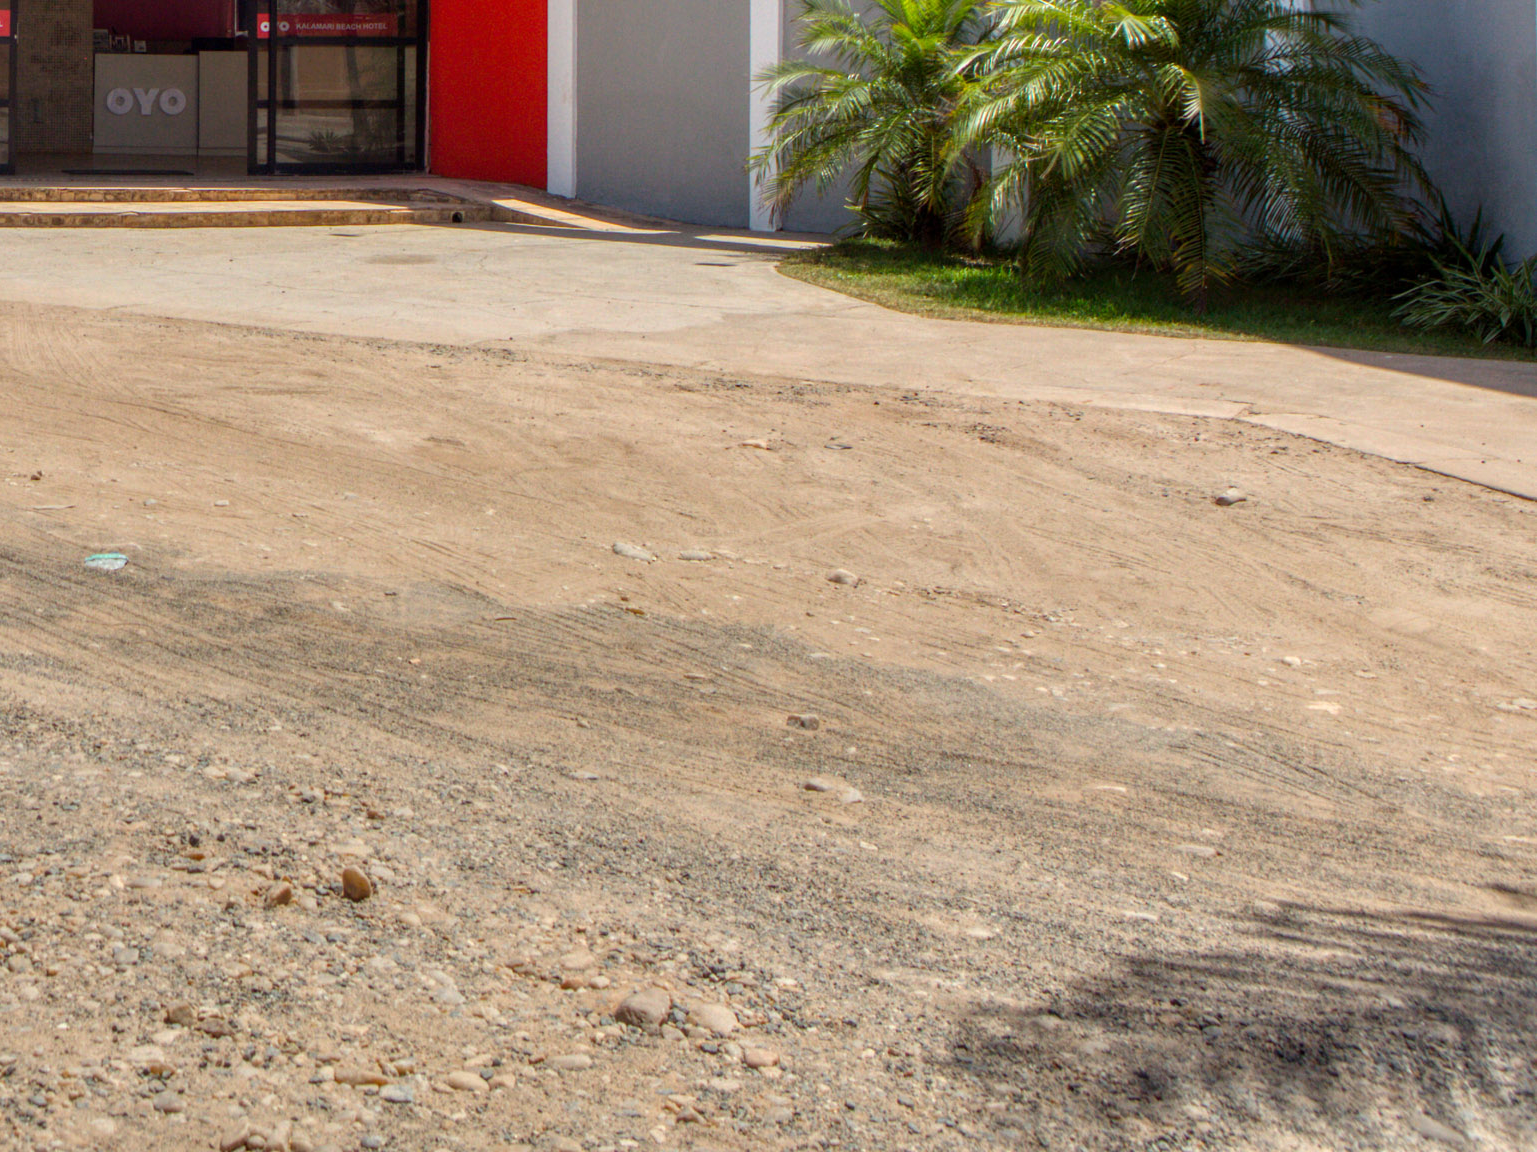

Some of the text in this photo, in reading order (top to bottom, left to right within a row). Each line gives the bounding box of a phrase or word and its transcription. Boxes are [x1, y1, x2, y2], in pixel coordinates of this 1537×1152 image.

[260, 21, 290, 32] OO
[362, 22, 388, 30] HOTEL
[106, 87, 187, 116] OYO
